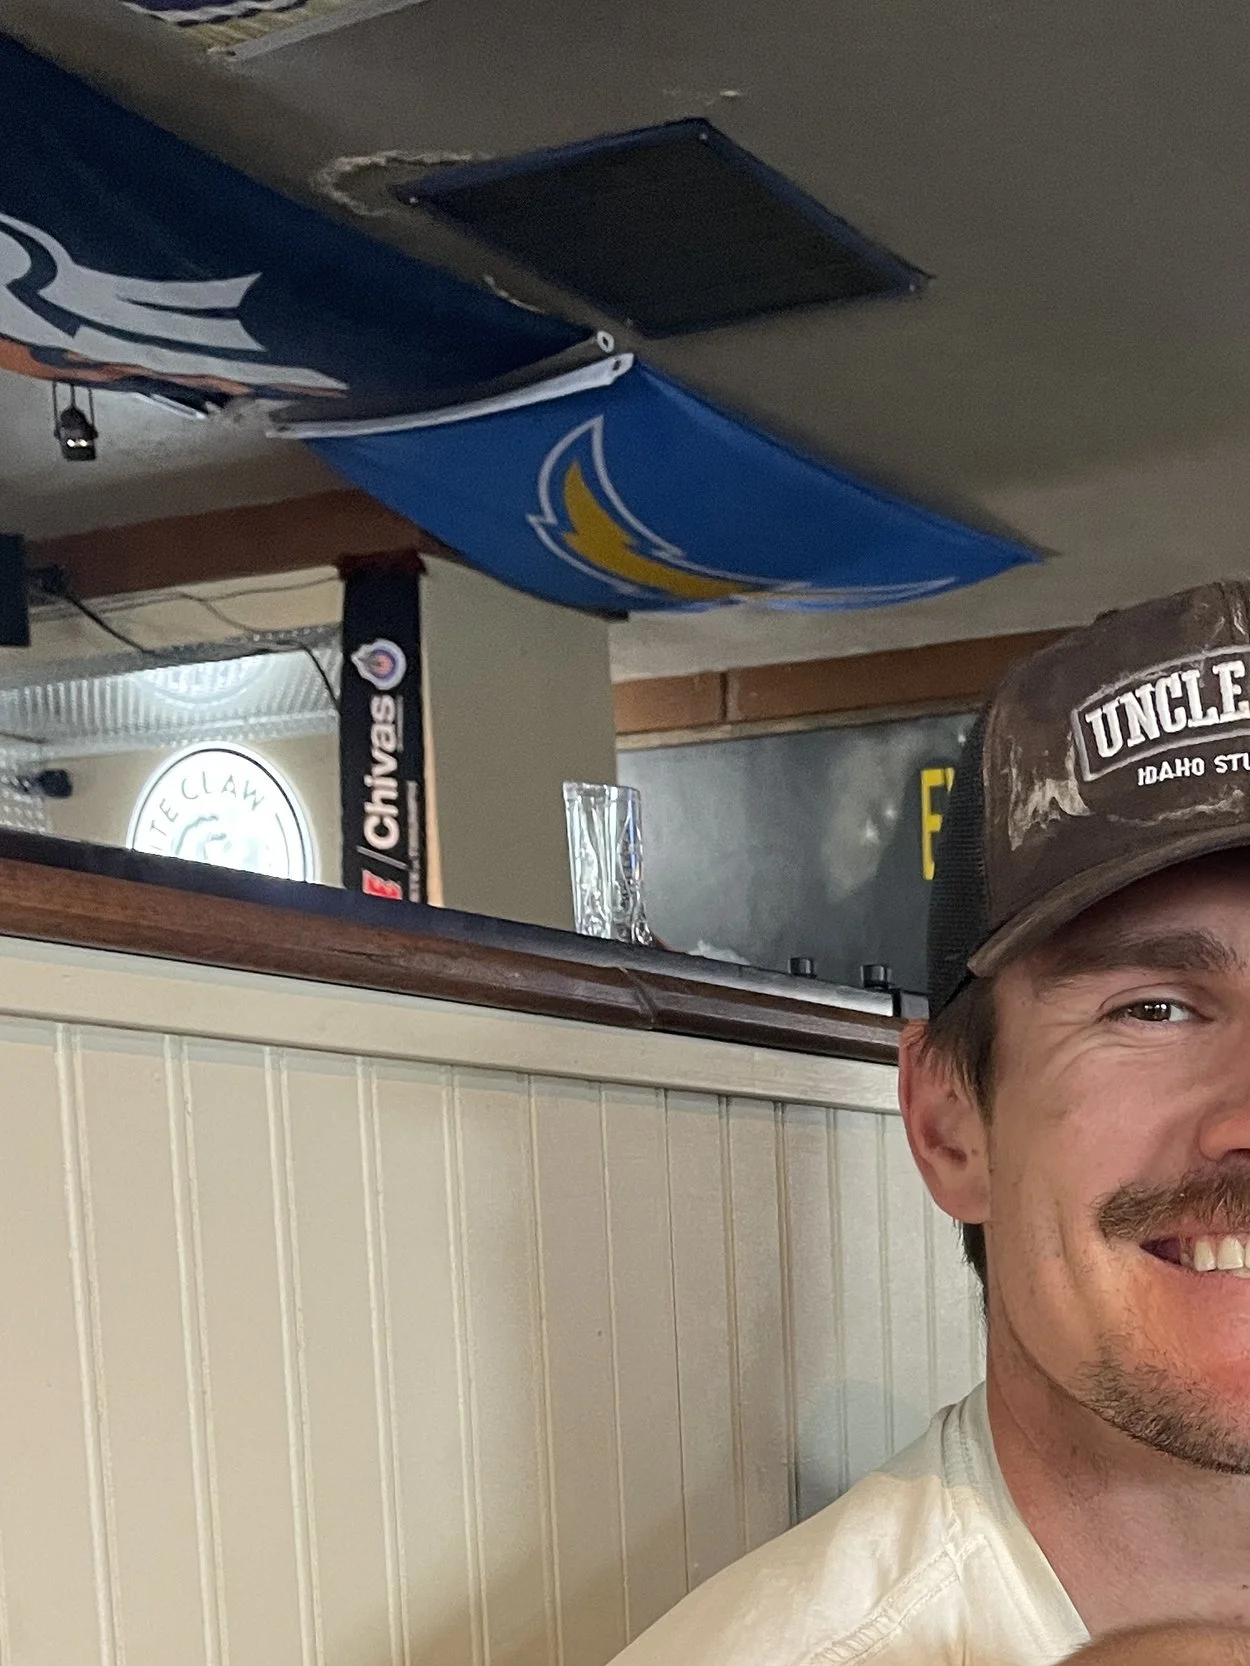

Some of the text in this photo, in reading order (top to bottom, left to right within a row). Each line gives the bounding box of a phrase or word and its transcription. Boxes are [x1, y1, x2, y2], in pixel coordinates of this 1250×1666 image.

[1085, 659, 1250, 759] UNCLE
[149, 770, 265, 851] ITE CLAW
[363, 694, 400, 851] Chivas
[1137, 756, 1206, 786] IDAHO
